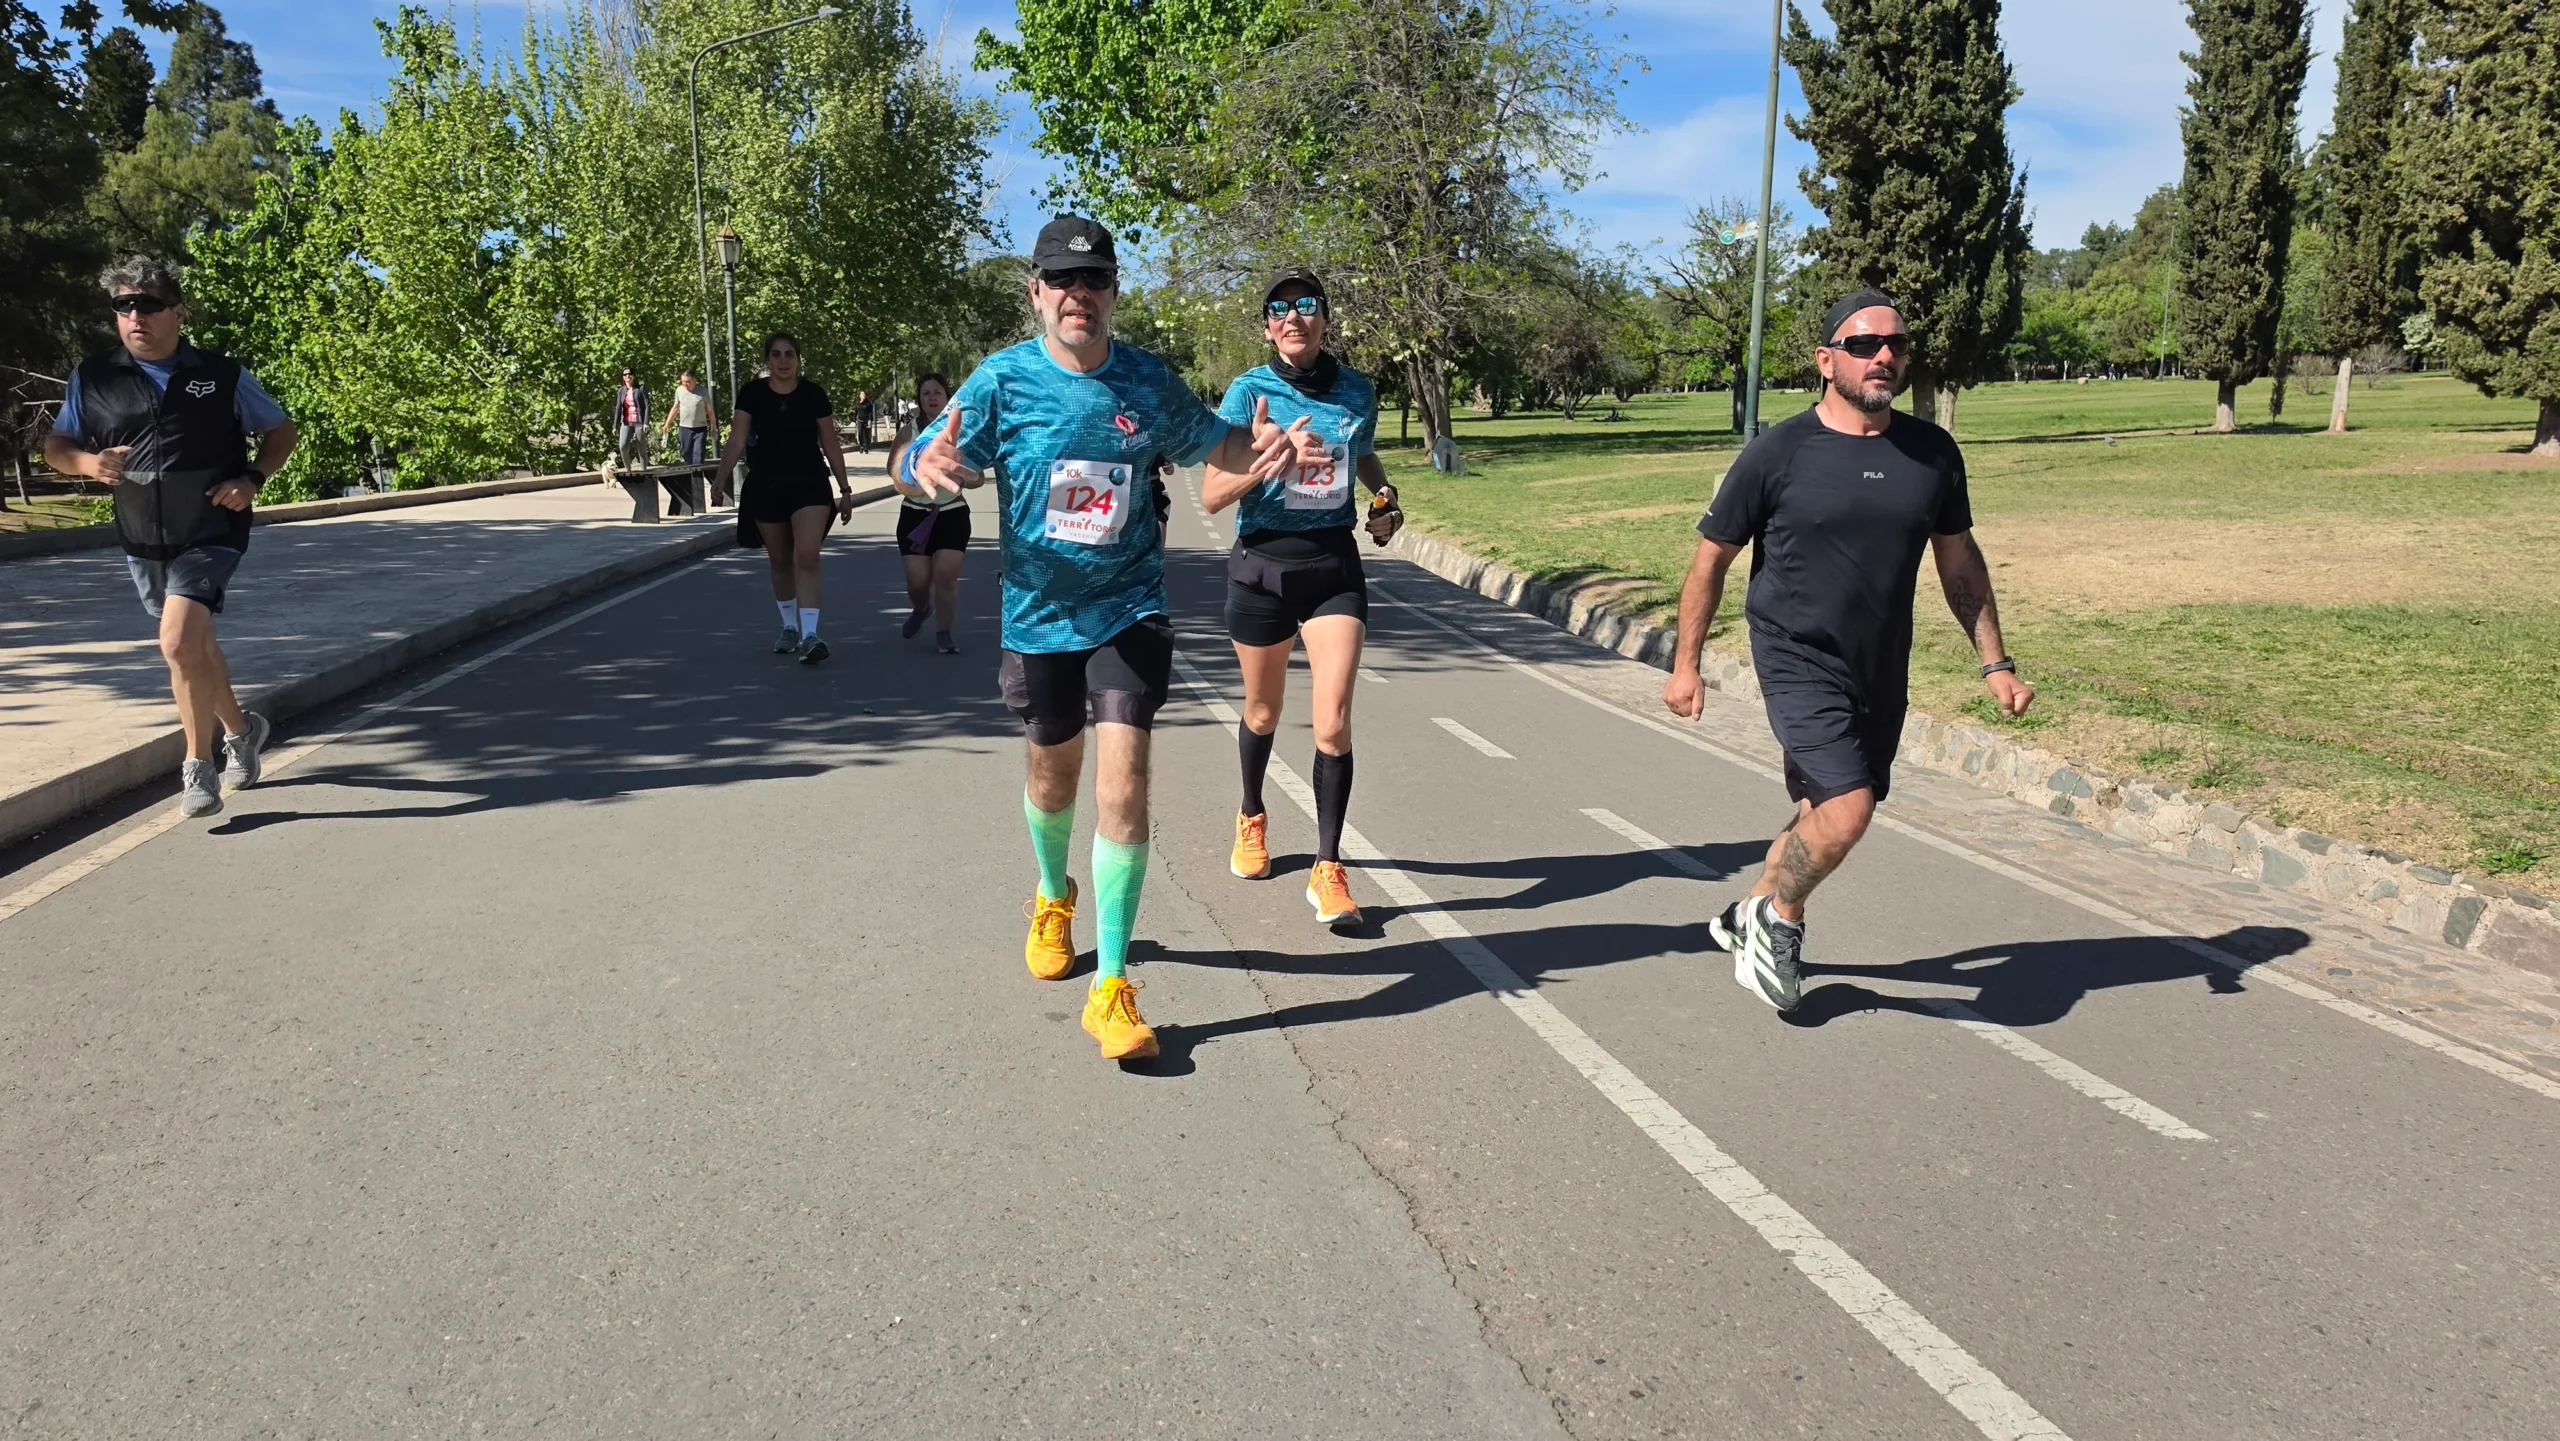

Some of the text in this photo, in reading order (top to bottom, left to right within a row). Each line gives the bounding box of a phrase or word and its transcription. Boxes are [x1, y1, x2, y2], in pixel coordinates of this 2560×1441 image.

[1298, 464, 1335, 486] 123
[1863, 471, 1885, 479] FILA
[1066, 485, 1113, 515] 124
